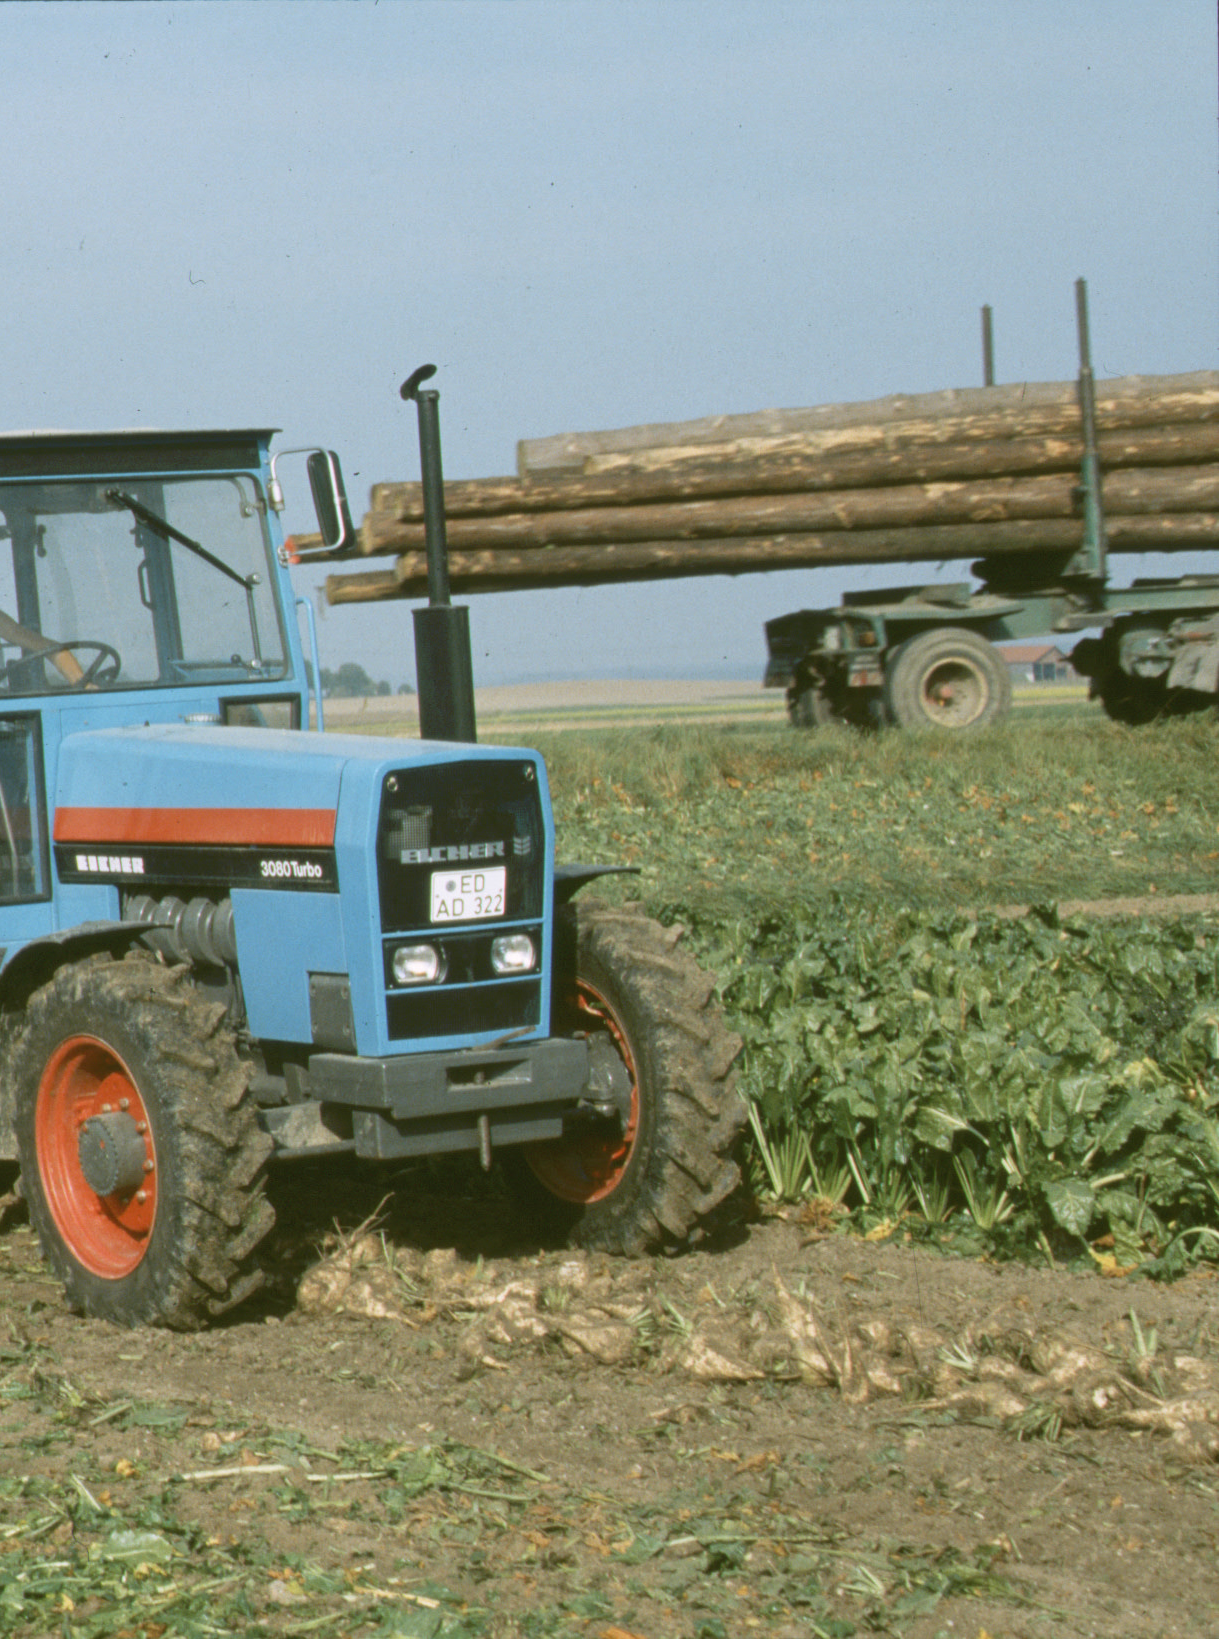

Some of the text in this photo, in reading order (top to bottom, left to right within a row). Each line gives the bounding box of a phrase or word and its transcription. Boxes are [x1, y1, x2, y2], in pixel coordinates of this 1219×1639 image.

[401, 841, 504, 864] EICHER
[76, 855, 144, 874] EICHER
[261, 861, 322, 878] 3080 Turbo
[461, 874, 485, 893] ED
[437, 894, 502, 917] AD 322
